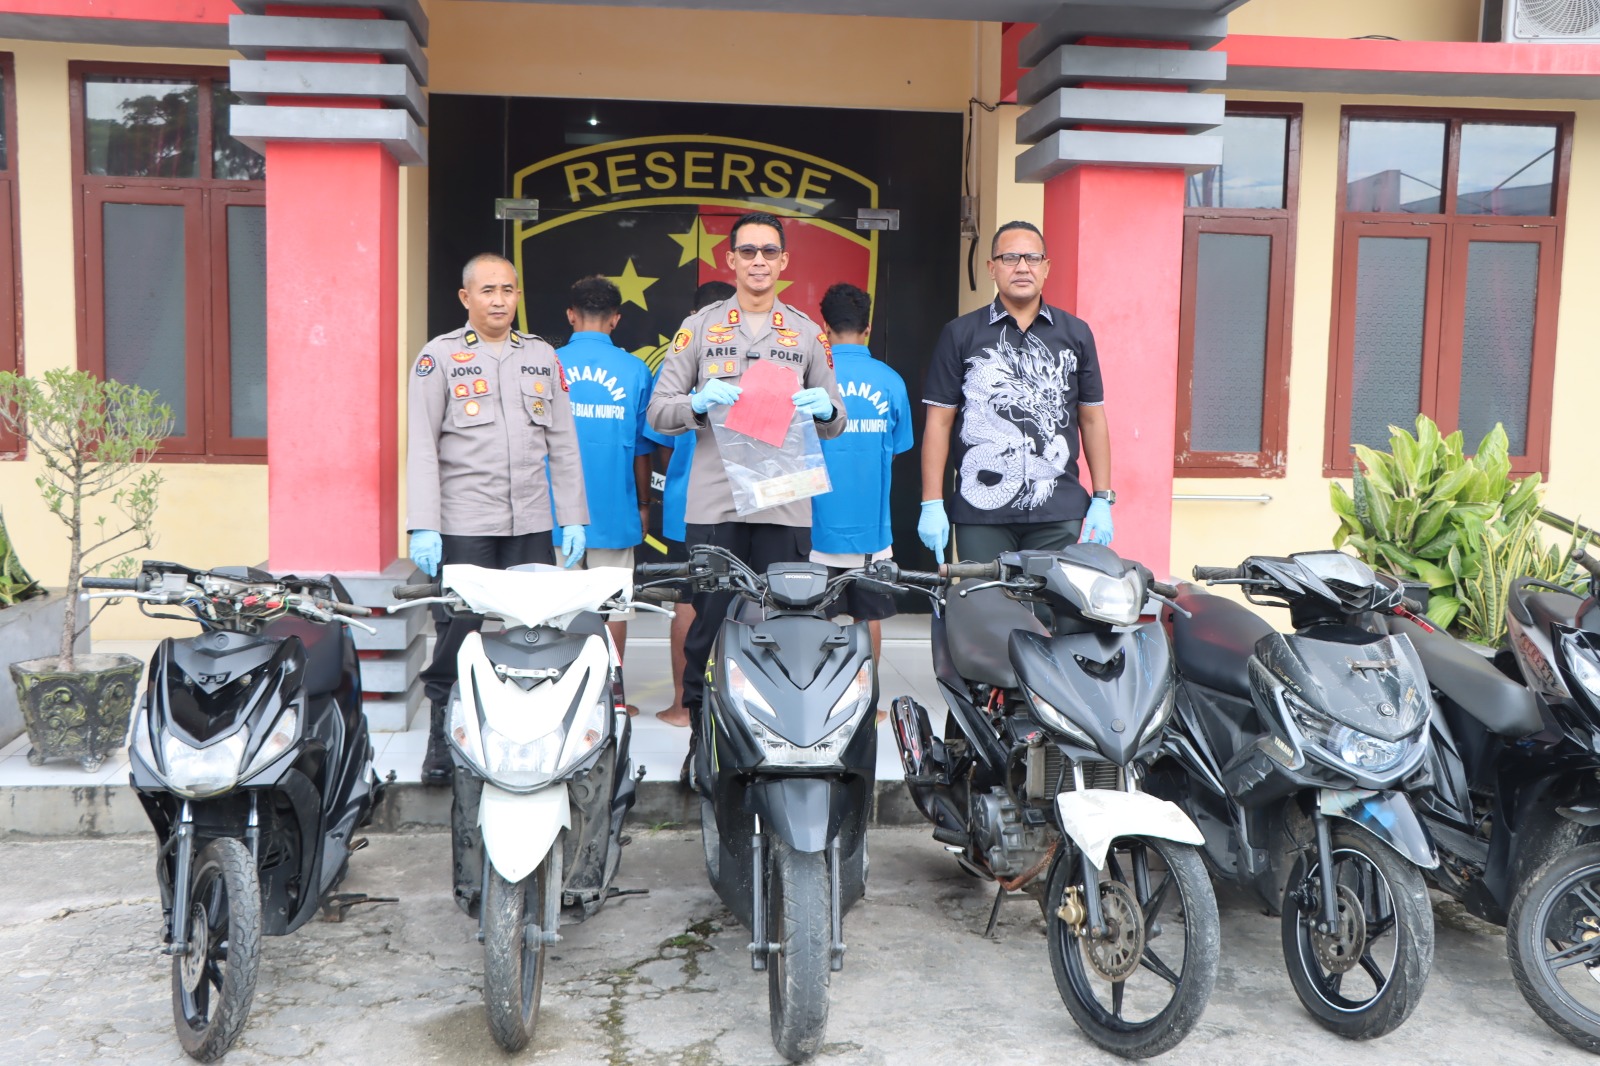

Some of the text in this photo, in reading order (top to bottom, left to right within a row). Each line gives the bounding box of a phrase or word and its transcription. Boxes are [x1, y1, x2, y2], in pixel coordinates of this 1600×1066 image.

[564, 151, 832, 209] RESERSE
[706, 347, 737, 358] ARIE
[770, 349, 803, 363] POLRI
[451, 366, 482, 377] JOKO
[521, 366, 550, 376] POLRI
[565, 366, 626, 402] HANAN
[576, 403, 594, 418] BIAK
[595, 404, 625, 420] NUMFOR
[1274, 736, 1294, 758] YAMAHA
